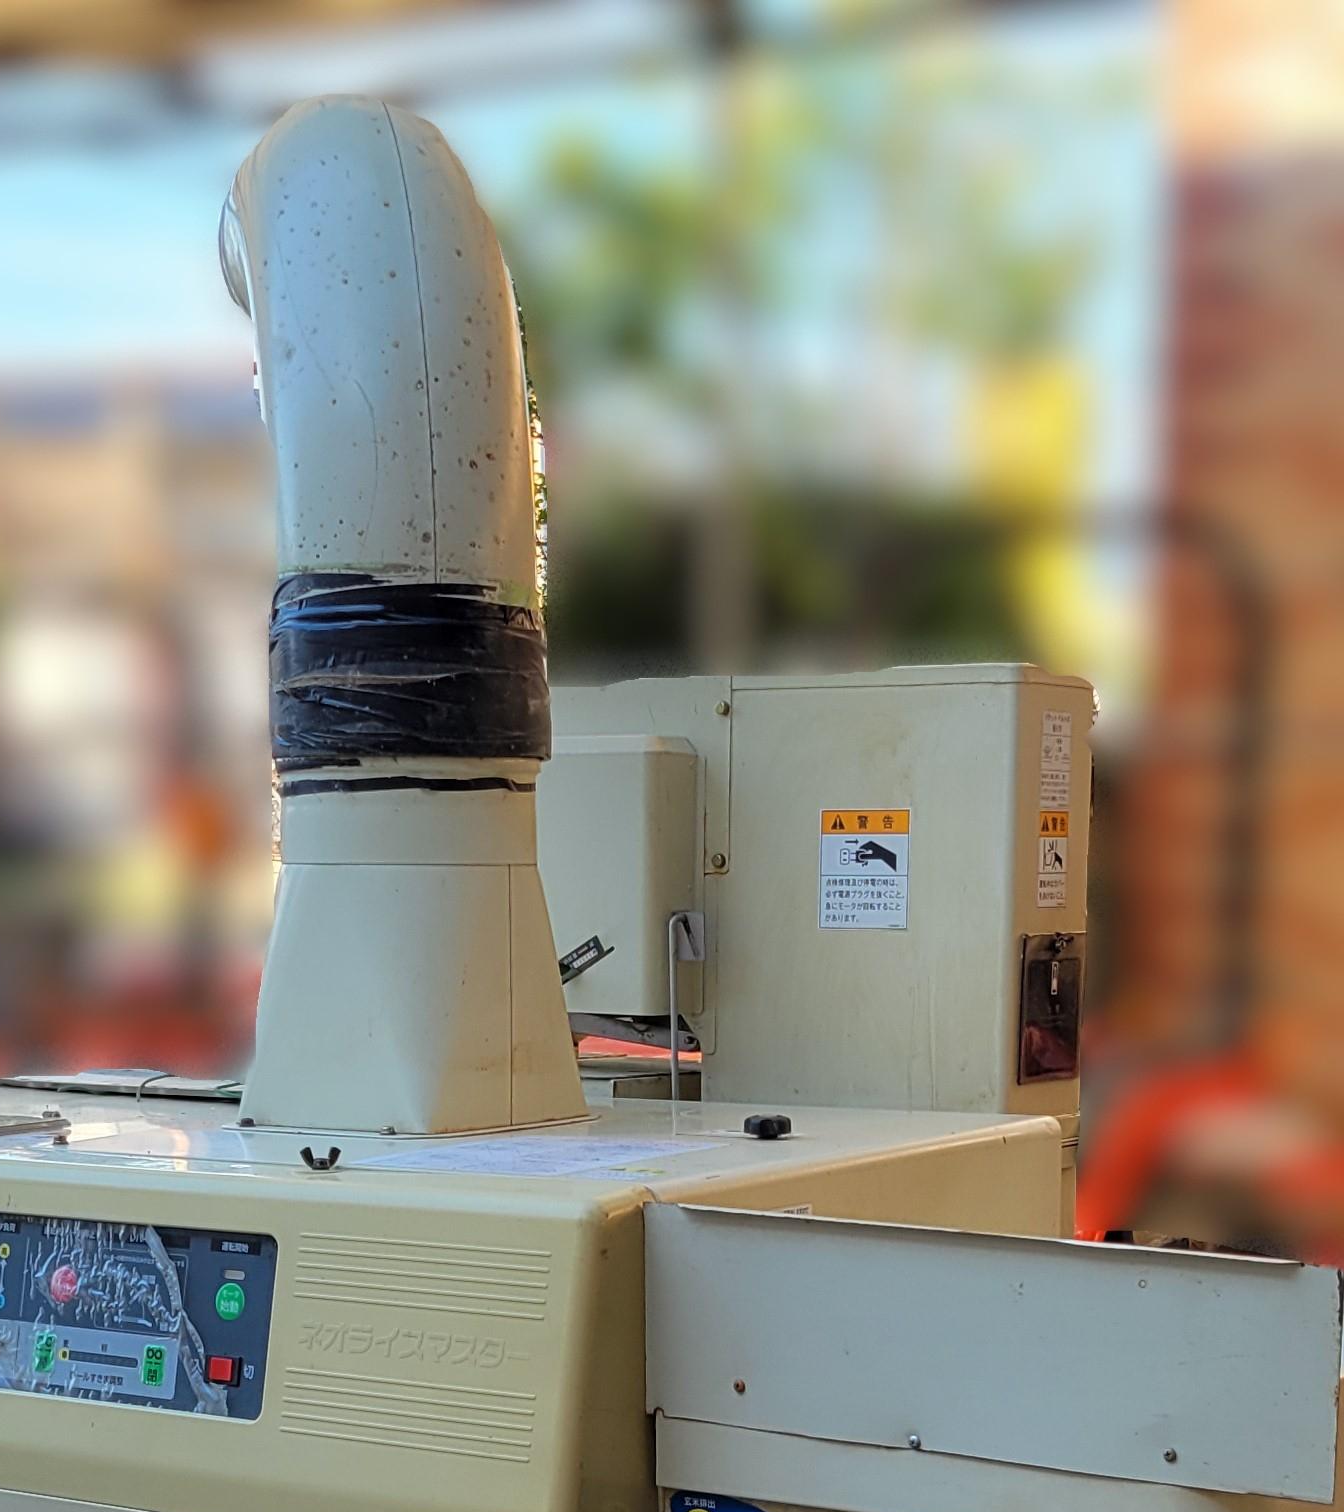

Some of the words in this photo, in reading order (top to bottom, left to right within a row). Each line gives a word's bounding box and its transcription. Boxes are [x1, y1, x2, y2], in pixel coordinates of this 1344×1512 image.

[857, 815, 894, 830] 警告
[298, 1320, 531, 1369] ネオライスマスター
